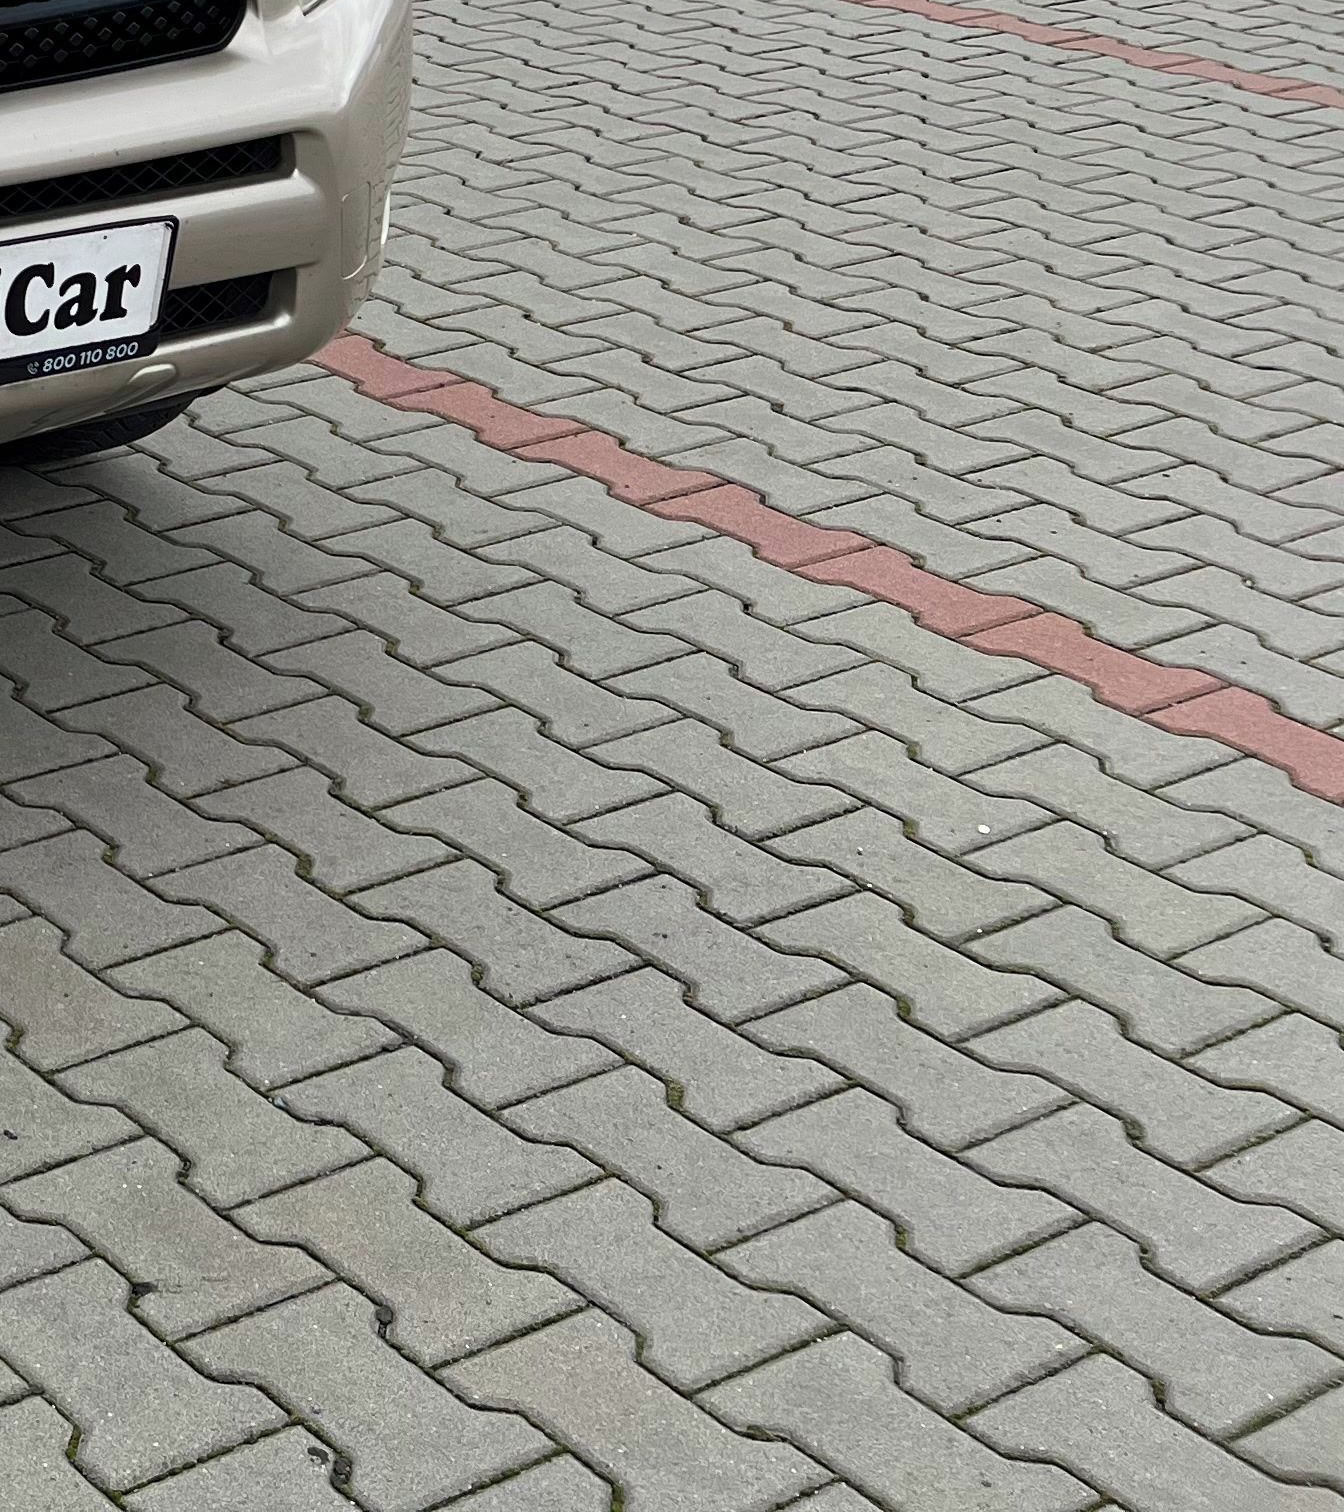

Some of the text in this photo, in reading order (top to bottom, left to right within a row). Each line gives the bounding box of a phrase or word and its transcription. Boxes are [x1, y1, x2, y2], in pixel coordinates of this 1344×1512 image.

[42, 341, 139, 373] 800 110 800
